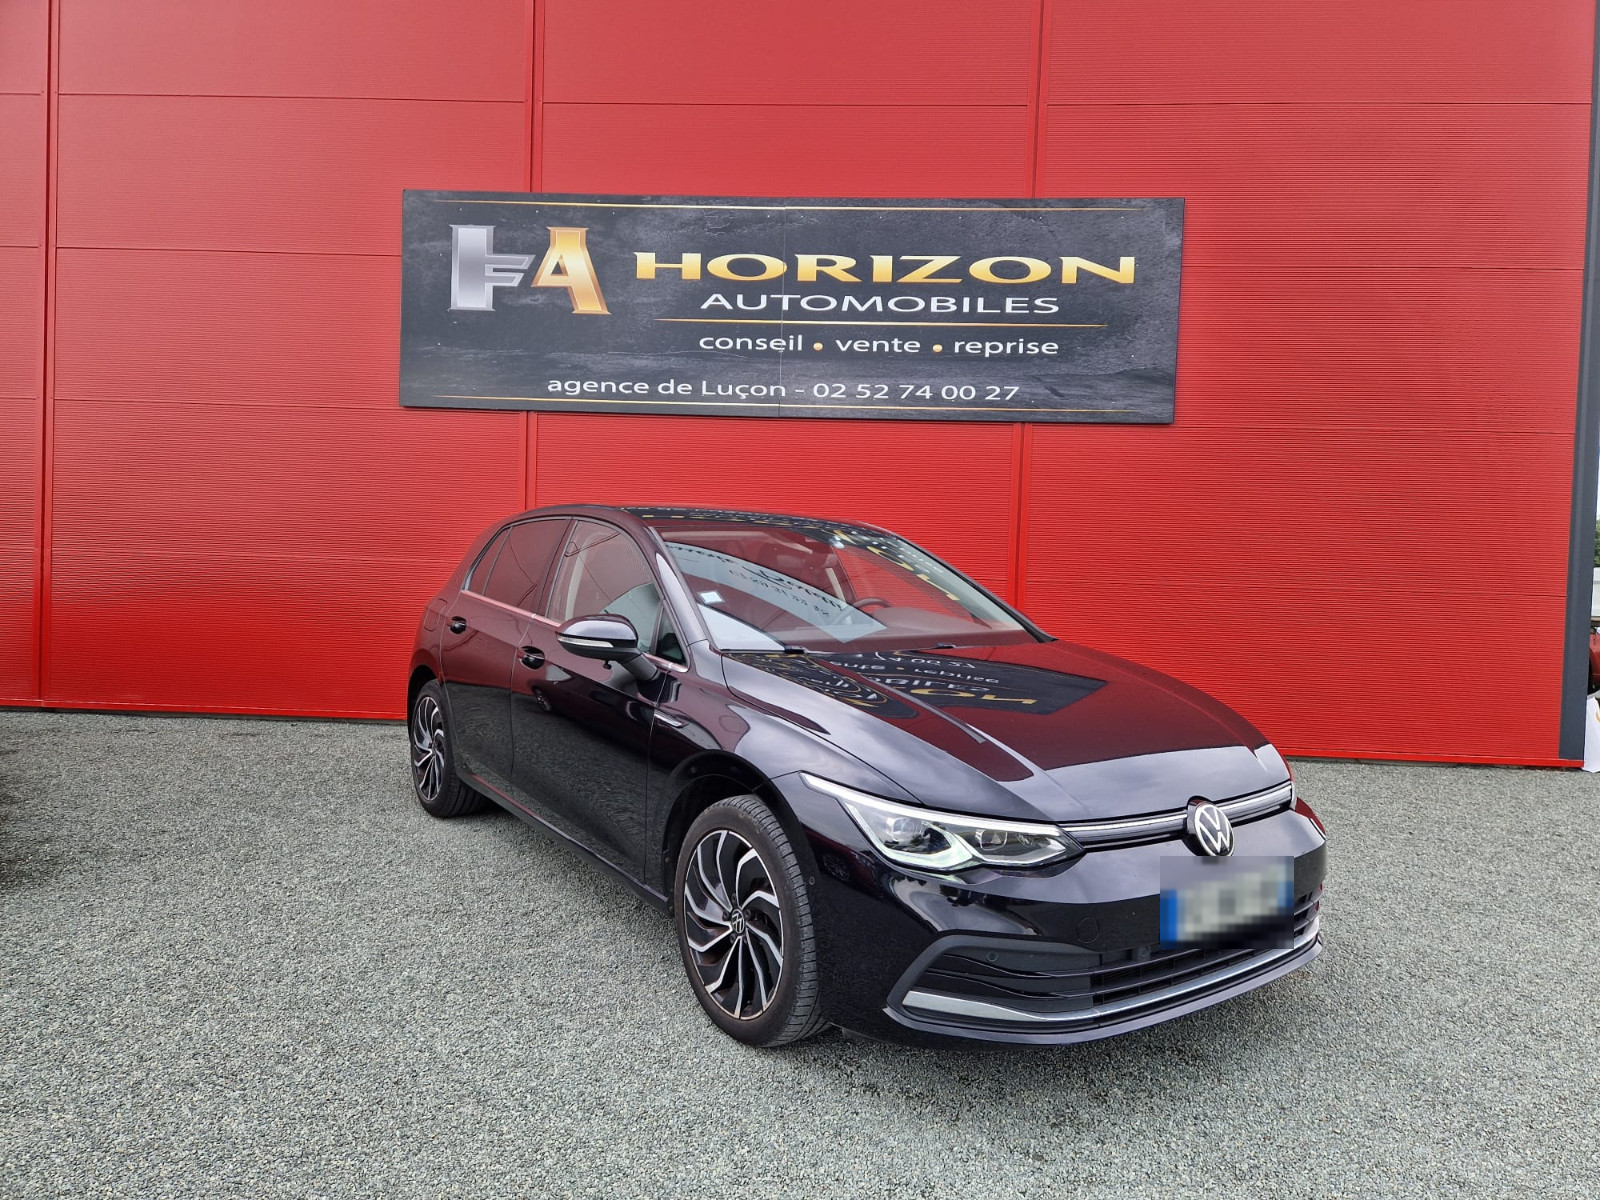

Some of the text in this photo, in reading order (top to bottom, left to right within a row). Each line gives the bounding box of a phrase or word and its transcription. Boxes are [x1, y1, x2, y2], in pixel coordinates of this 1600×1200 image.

[634, 251, 1136, 284] HORIZON
[700, 293, 1060, 314] AUTOMOBILES
[699, 334, 1059, 357] conseil vente reprise
[547, 378, 649, 396] agence
[657, 378, 693, 395] de
[701, 379, 787, 400] Luçon
[812, 382, 847, 399] 02
[855, 383, 889, 400] 52
[899, 383, 933, 400] 74
[941, 385, 976, 401] 00
[984, 386, 1020, 401] 27
